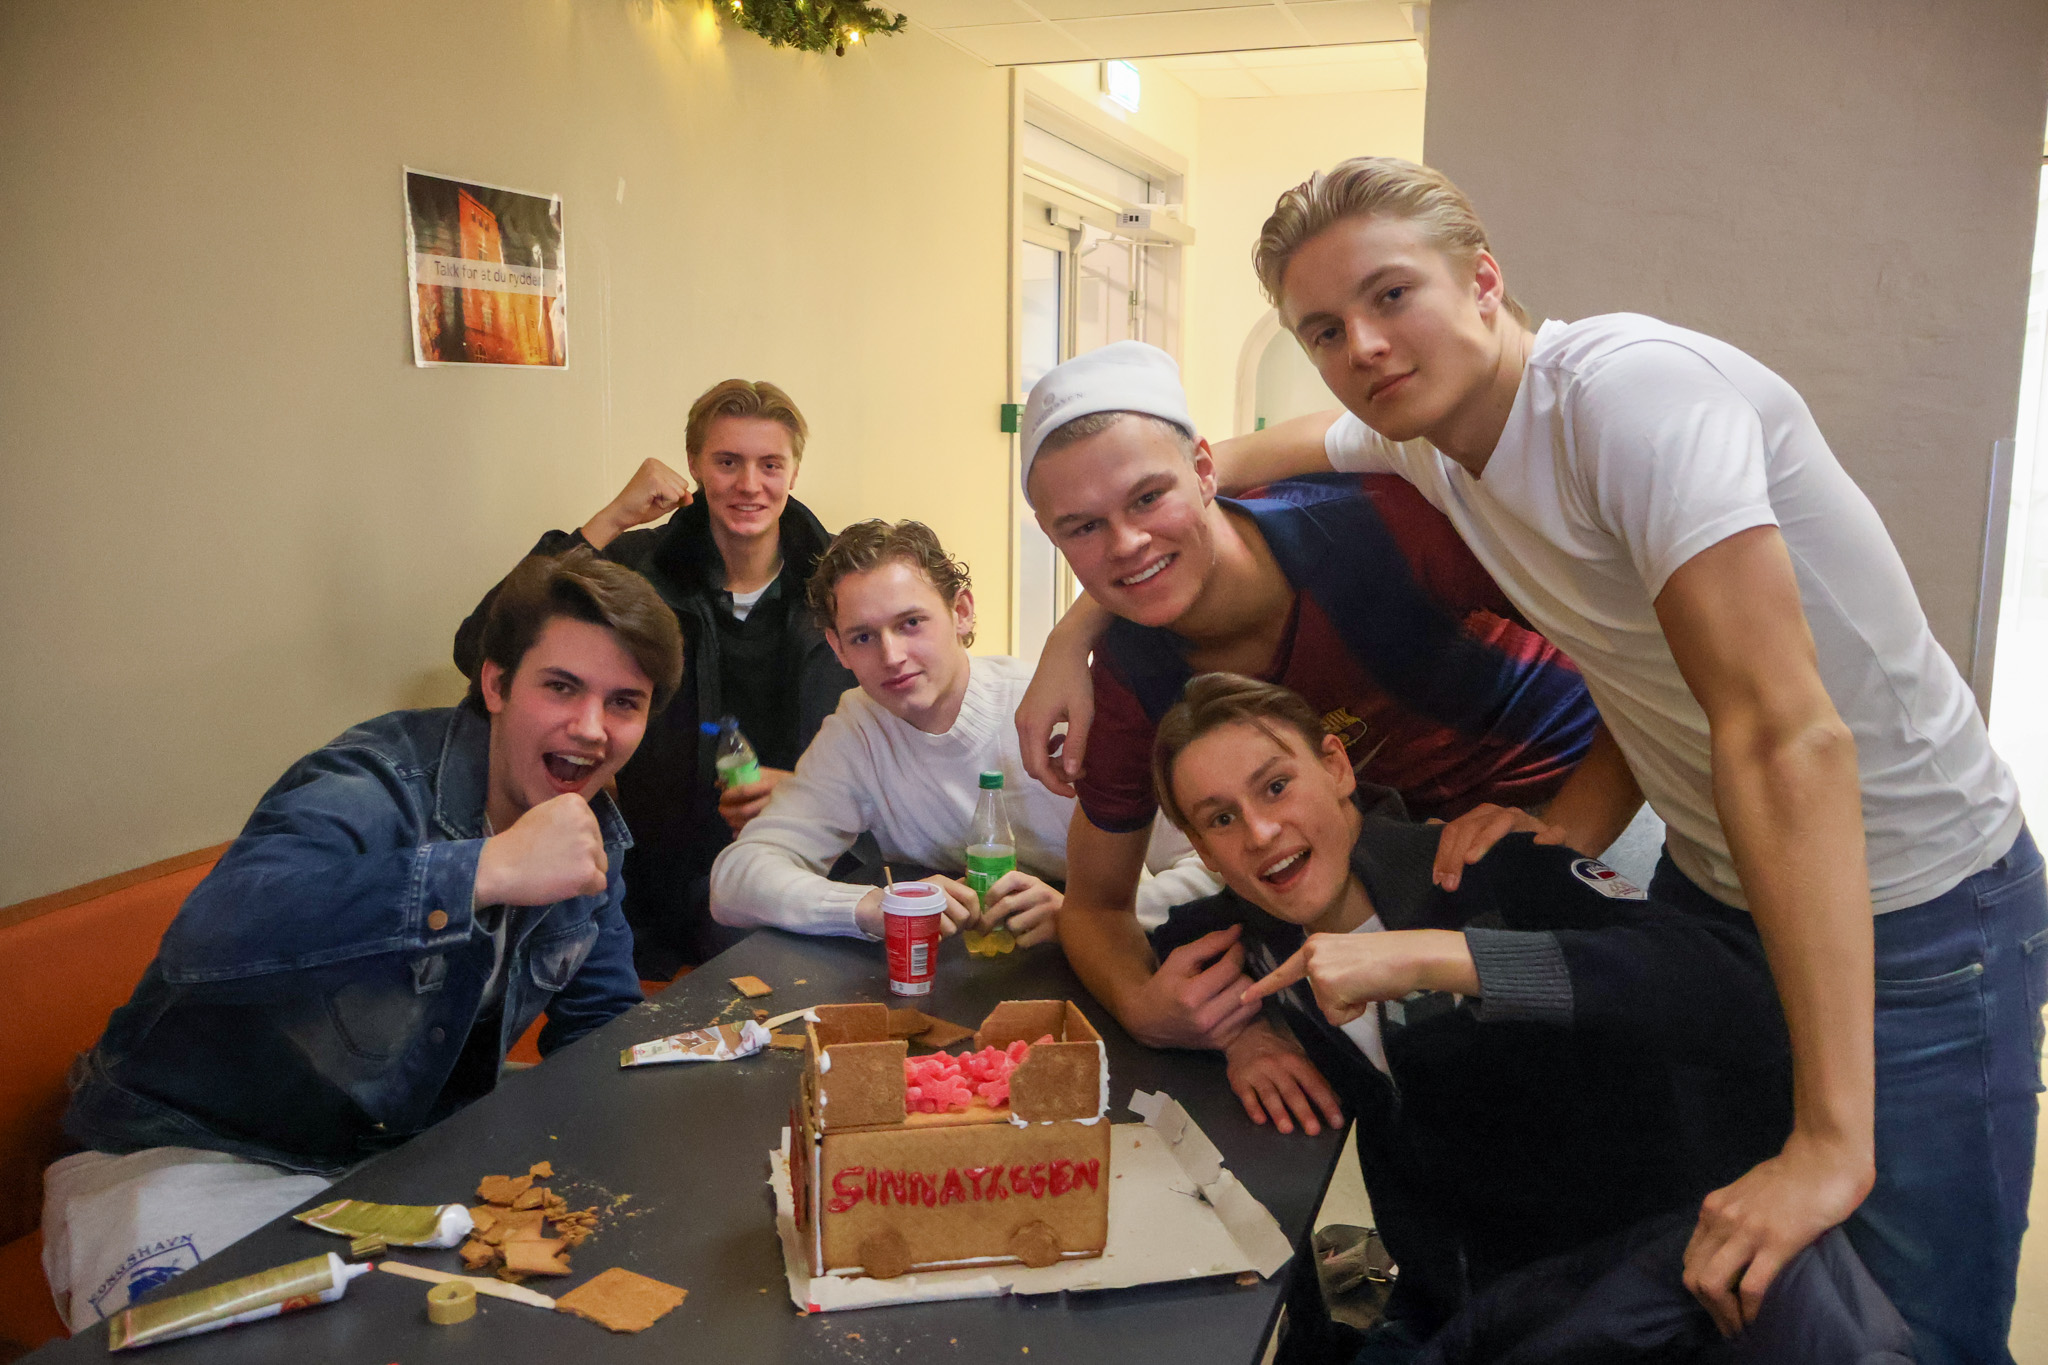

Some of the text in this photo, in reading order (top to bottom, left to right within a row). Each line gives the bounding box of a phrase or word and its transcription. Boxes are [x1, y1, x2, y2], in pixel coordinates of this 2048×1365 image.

[434, 261, 459, 278] Takk
[462, 264, 477, 279] for
[481, 268, 491, 281] at
[494, 269, 506, 283] du
